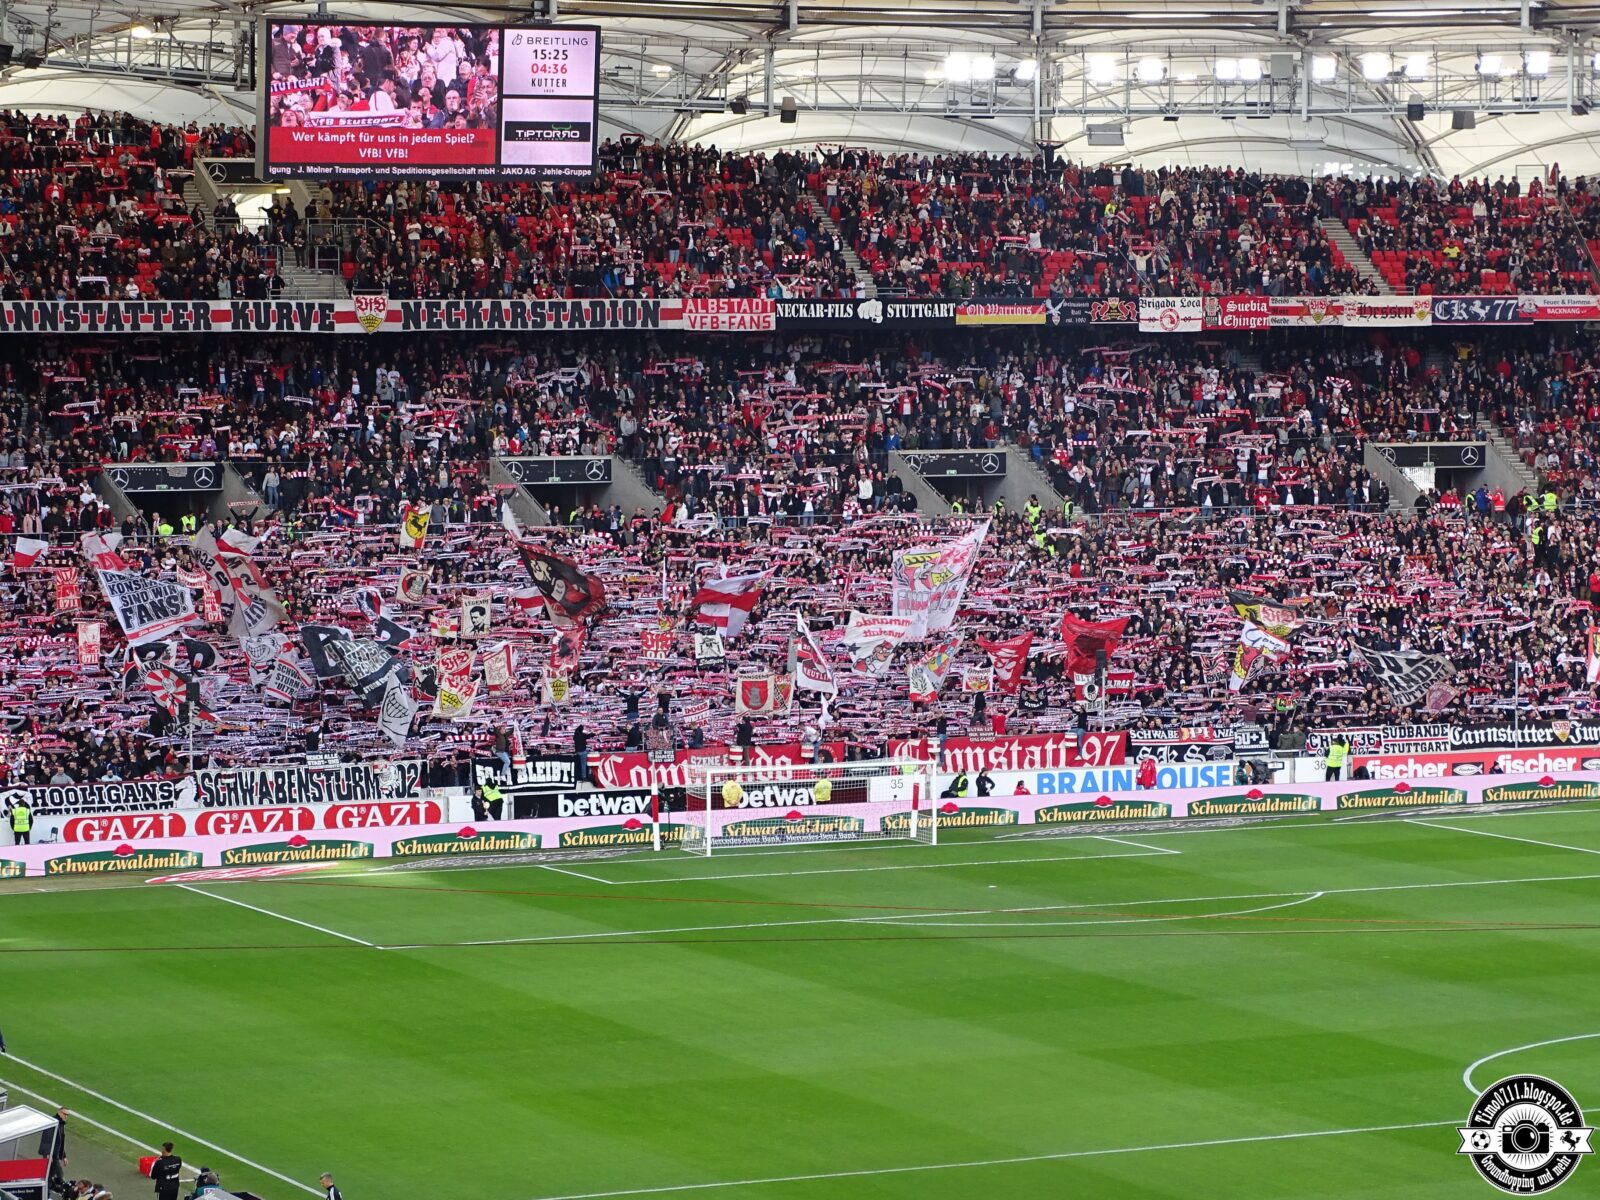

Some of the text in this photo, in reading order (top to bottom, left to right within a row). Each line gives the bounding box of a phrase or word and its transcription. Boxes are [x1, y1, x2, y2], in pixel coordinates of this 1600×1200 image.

[527, 37, 588, 46] BREITLING
[533, 49, 569, 60] 15:25
[531, 63, 568, 74] 04:36
[531, 78, 567, 88] KUTTER
[292, 132, 475, 147] Wer kämpft für uns in jedem Spiel?
[359, 148, 408, 160] VfB! VfB!
[375, 167, 390, 175] und
[477, 167, 495, 176] mbH
[501, 167, 523, 175] JAKO
[524, 167, 537, 175] AG
[542, 168, 592, 177] Jehle-Gruppe
[685, 299, 773, 314] ALBSTADT
[776, 303, 956, 318] NECKAR-FILS STUTTGART
[966, 303, 1033, 317] Old Warriors
[1140, 297, 1201, 311] Brigada Loca
[1226, 300, 1268, 313] Suebia
[1493, 299, 1518, 320] 77
[231, 301, 335, 332] KURVE
[688, 314, 772, 330] VFB-FANS
[120, 591, 189, 632] FANS!
[1234, 731, 1269, 746] 50+1
[1357, 733, 1376, 747] 36
[1082, 735, 1121, 770] 97
[1384, 741, 1449, 755] STUTTGART
[690, 755, 722, 768] SZENE
[1314, 760, 1326, 771] 36
[1497, 753, 1577, 774] fischer
[517, 760, 575, 783] BLEIBT!
[1366, 759, 1448, 780] fischer
[891, 779, 904, 790] 35
[28, 781, 174, 808] HOOLIGANS
[1340, 790, 1463, 808] Schwarzwaldmilch
[1038, 804, 1168, 822] Schwarzwaldmilch
[1191, 797, 1318, 815] Schwarzwaldmilch
[395, 835, 537, 855] Schwarzwaldmilch
[225, 843, 369, 865] Schwarzwaldmilch
[49, 852, 198, 874] Schwarzwaldmilch
